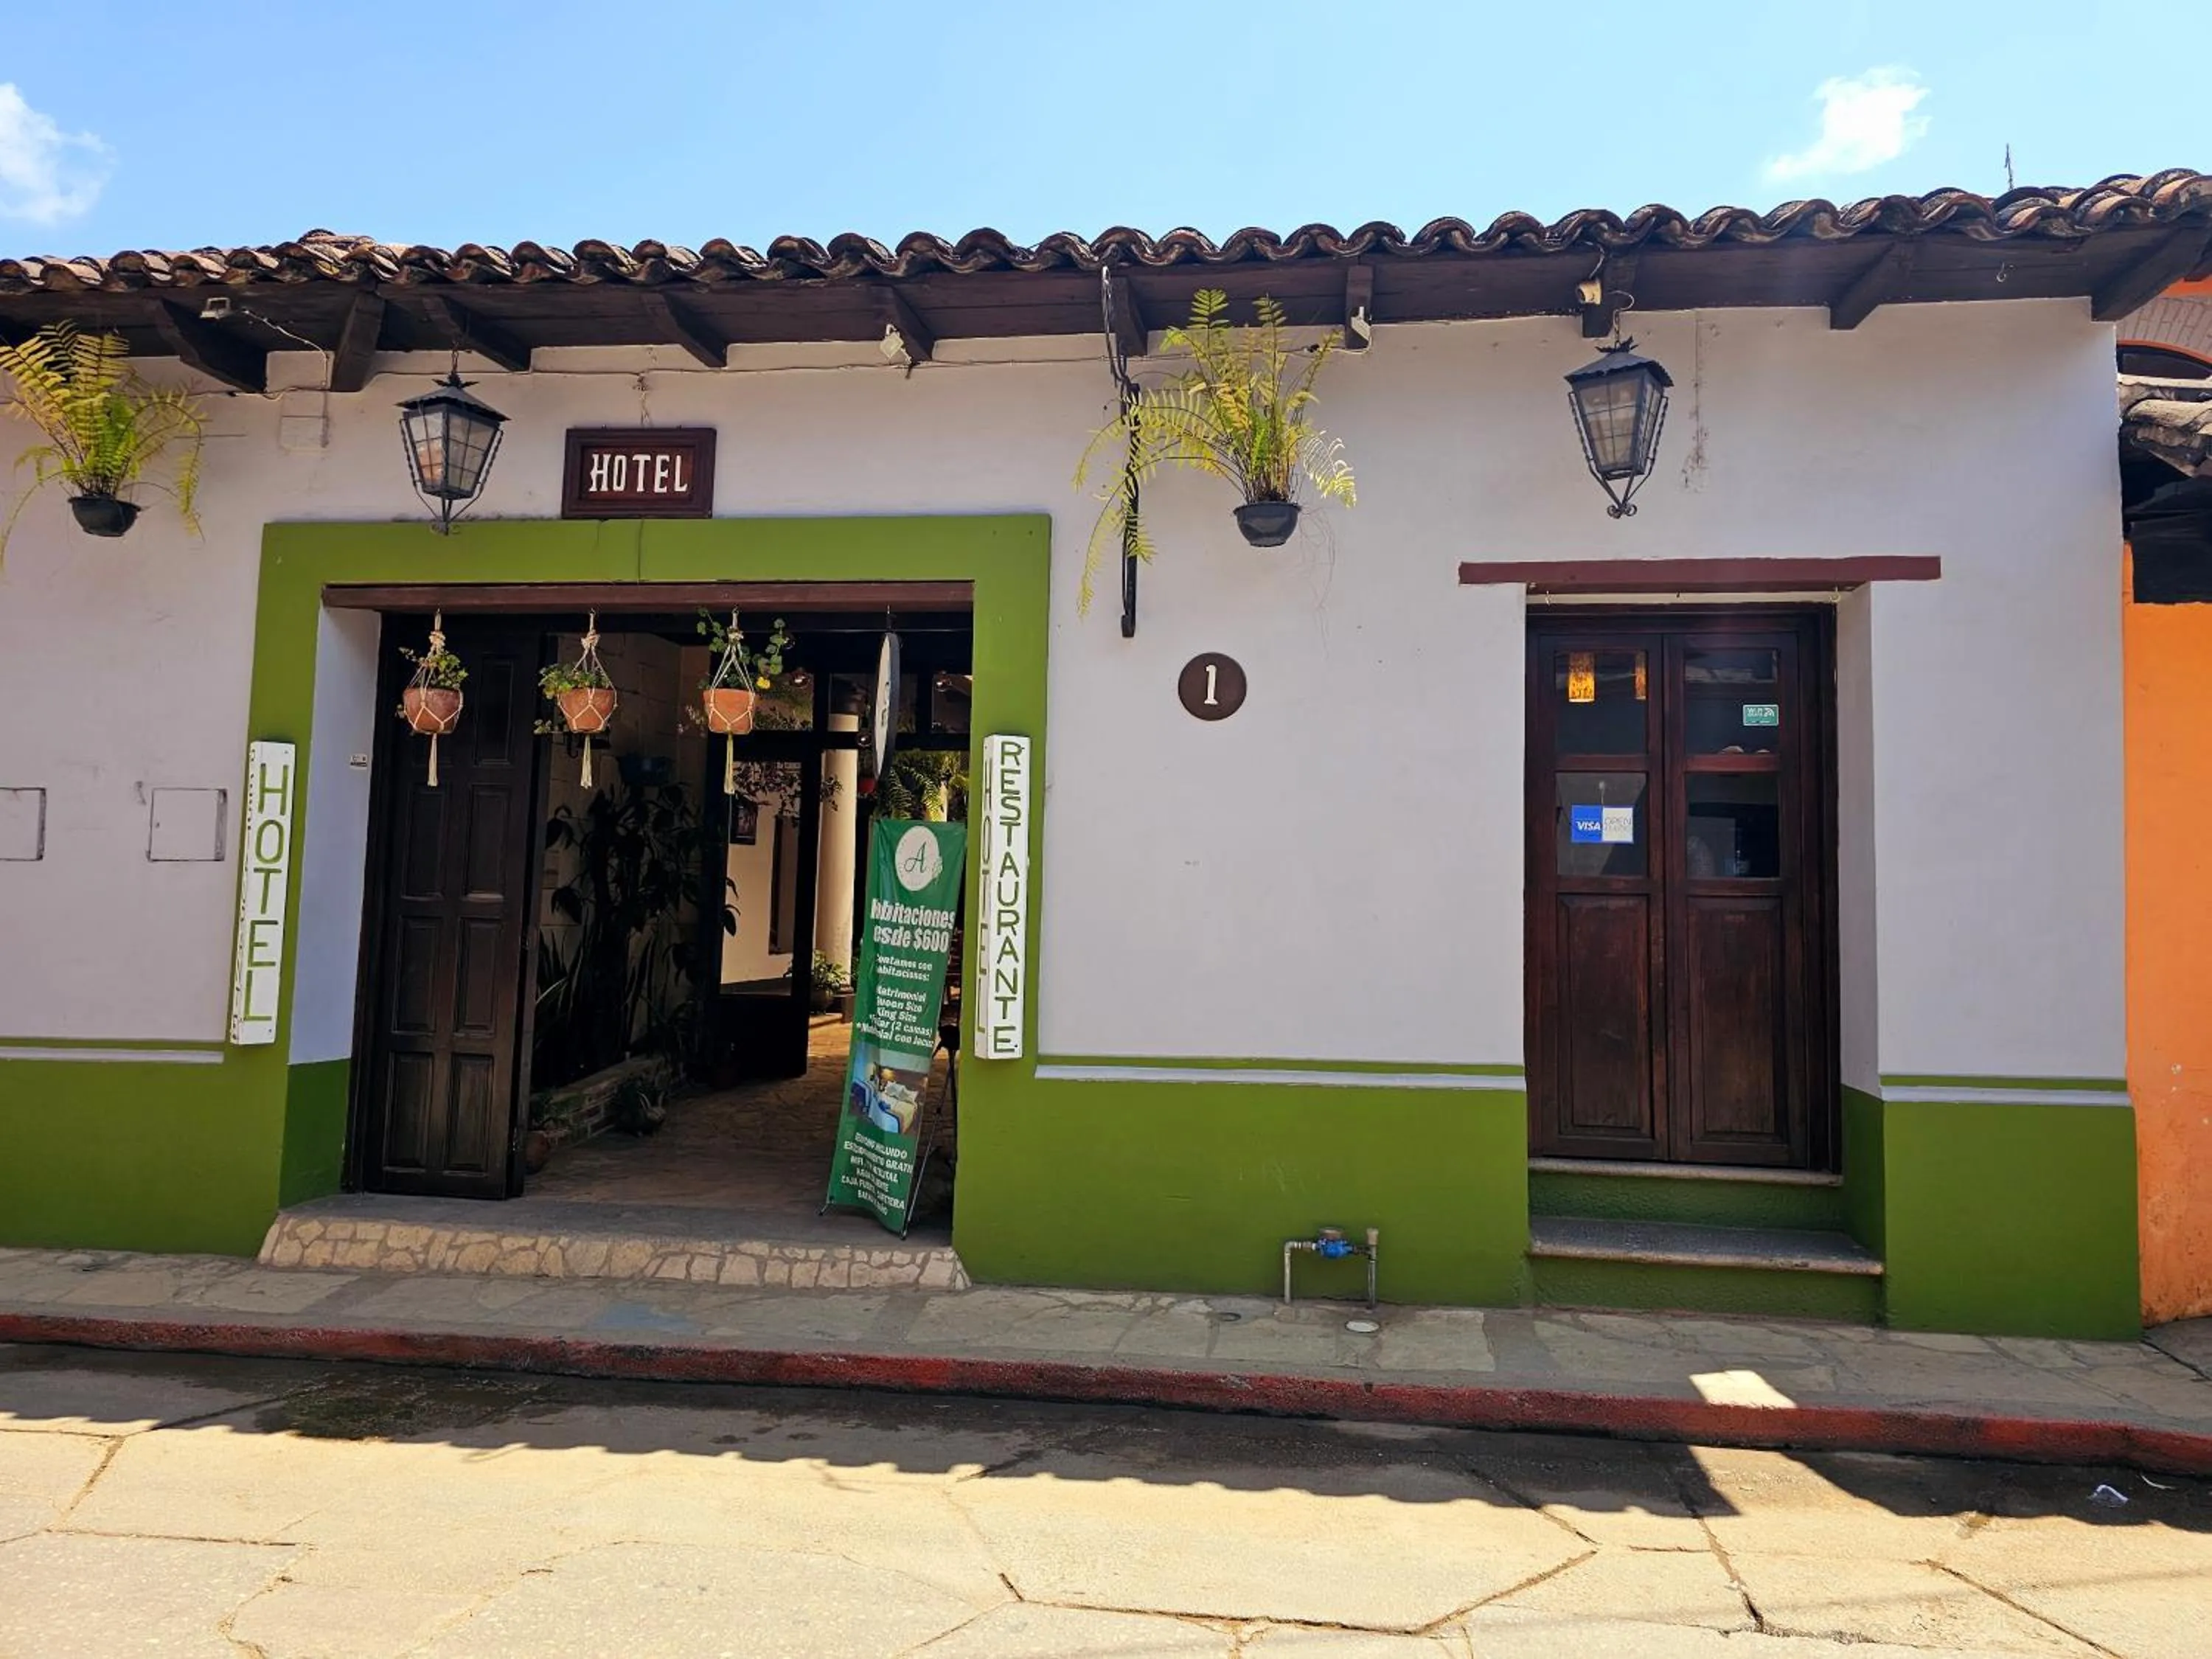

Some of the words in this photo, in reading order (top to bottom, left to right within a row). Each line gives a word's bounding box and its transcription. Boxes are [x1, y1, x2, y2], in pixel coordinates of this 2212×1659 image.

[588, 453, 688, 493] HOTEL
[1203, 664, 1219, 705] 1
[1575, 821, 1601, 832] VISA
[244, 763, 288, 1021] HOTEL
[977, 758, 992, 1034] HOTEL
[994, 741, 1023, 1053] RESTAURANTE
[914, 928, 949, 953] $600
